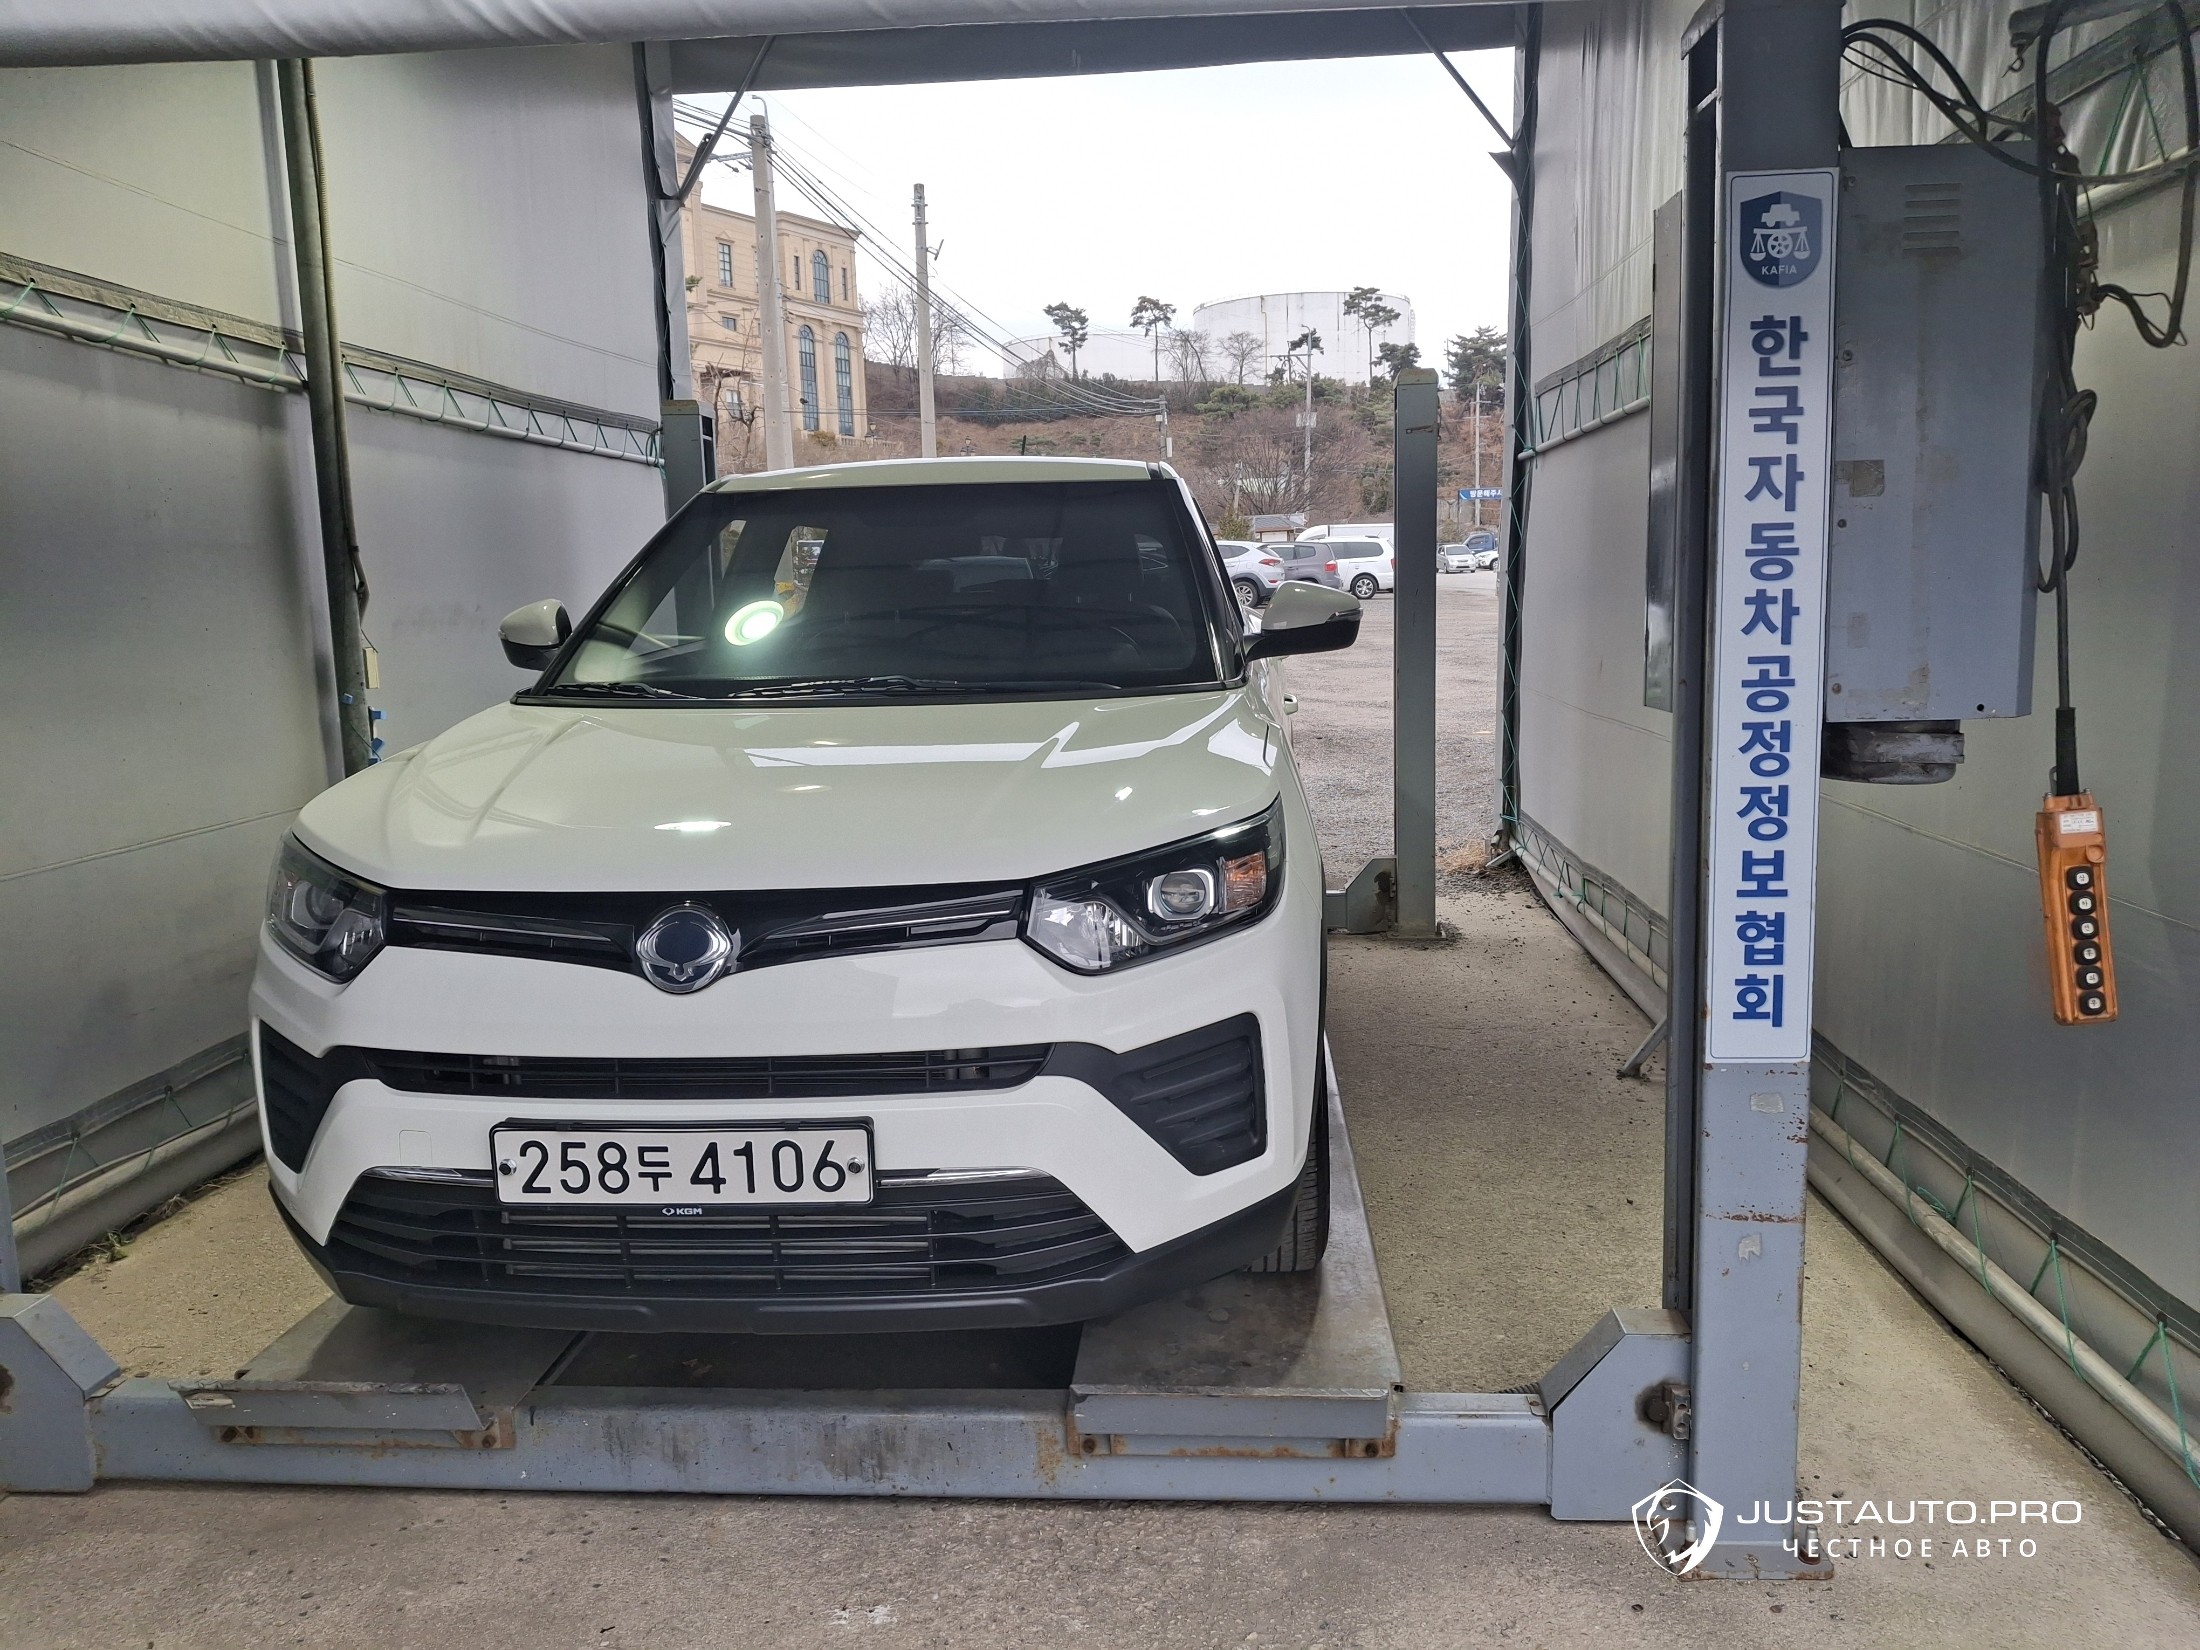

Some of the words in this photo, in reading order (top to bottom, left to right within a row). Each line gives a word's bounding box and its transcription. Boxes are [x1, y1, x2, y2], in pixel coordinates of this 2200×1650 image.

[1761, 265, 1798, 276] KAFIA
[1732, 314, 1809, 1028] 한국자동차공정정보협회
[519, 1140, 672, 1195] 258두
[690, 1140, 846, 1194] 4106
[676, 1207, 703, 1216] KGM
